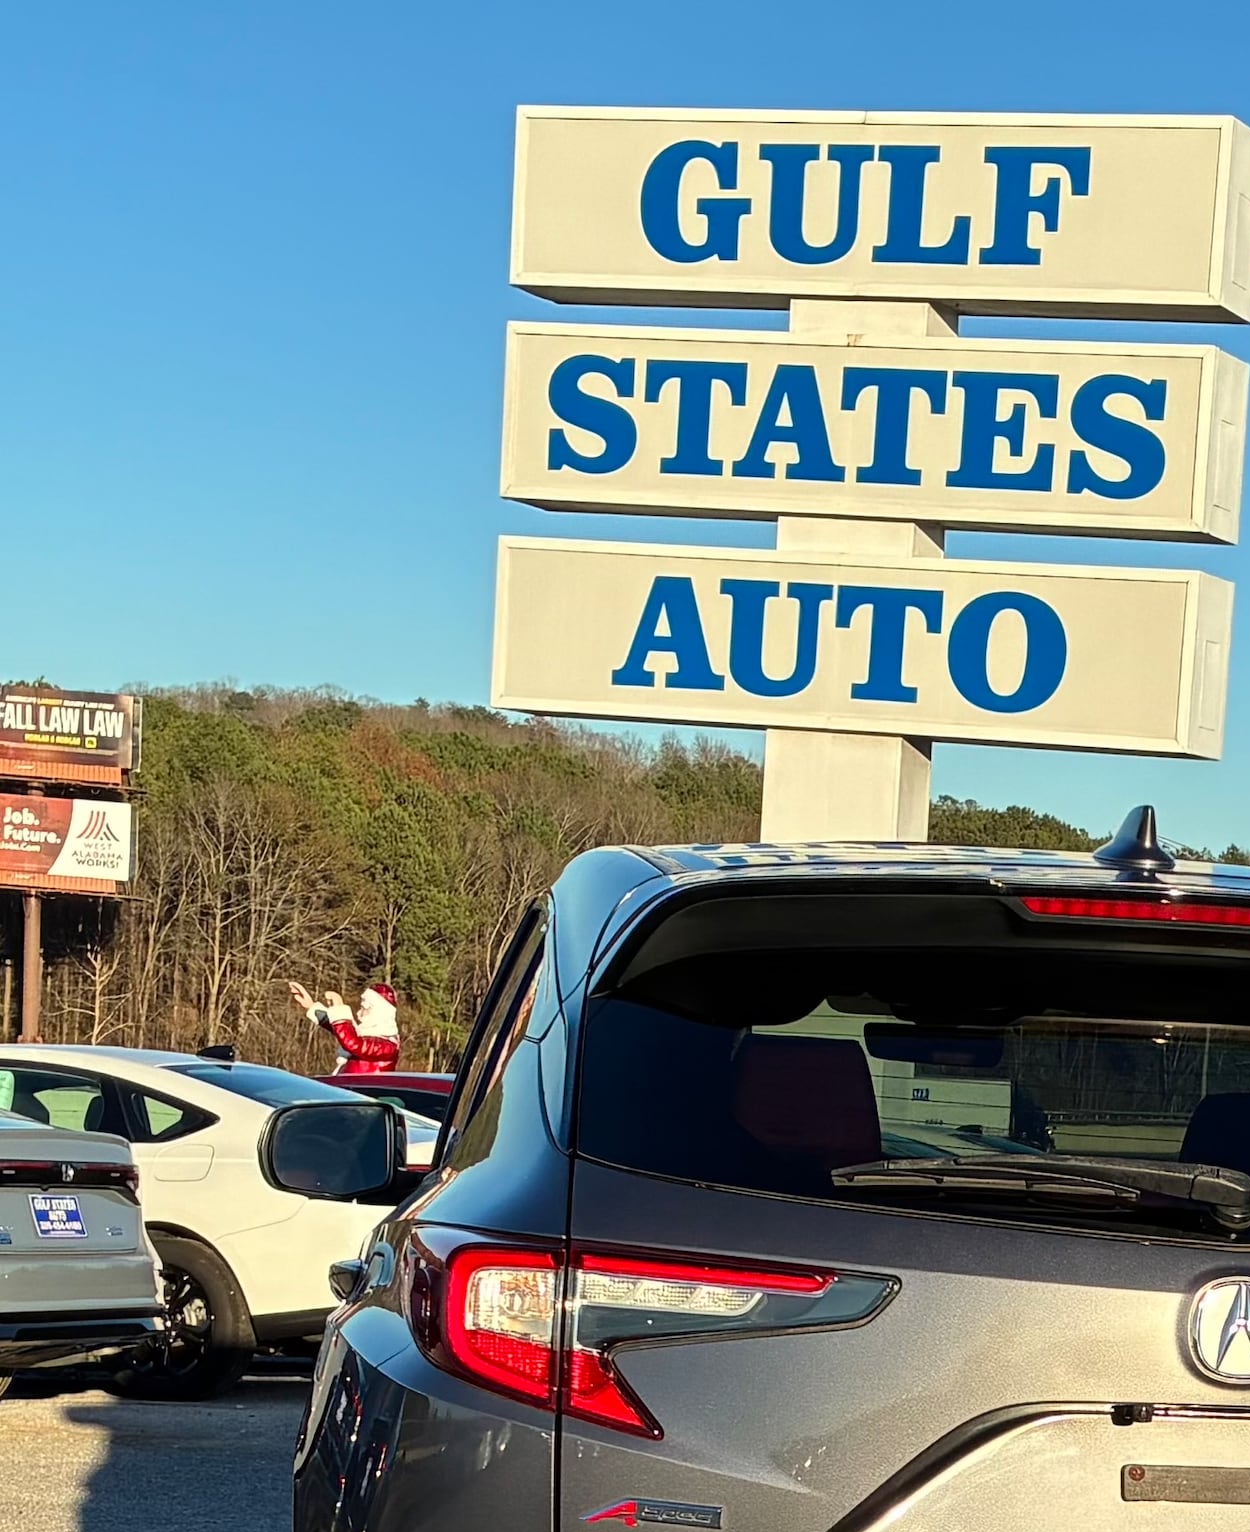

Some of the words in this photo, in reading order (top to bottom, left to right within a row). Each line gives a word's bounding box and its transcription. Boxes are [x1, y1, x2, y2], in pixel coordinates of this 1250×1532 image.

[639, 139, 1091, 266] GULF
[546, 353, 1168, 500] STATES
[610, 575, 1068, 714] AUTO
[39, 705, 80, 734] LAW
[83, 709, 124, 738] LAW
[3, 806, 40, 826] Job.
[3, 825, 61, 845] Future.
[71, 850, 123, 861] ALABAMA
[84, 842, 113, 851] WEST
[76, 858, 119, 869] WORKS!
